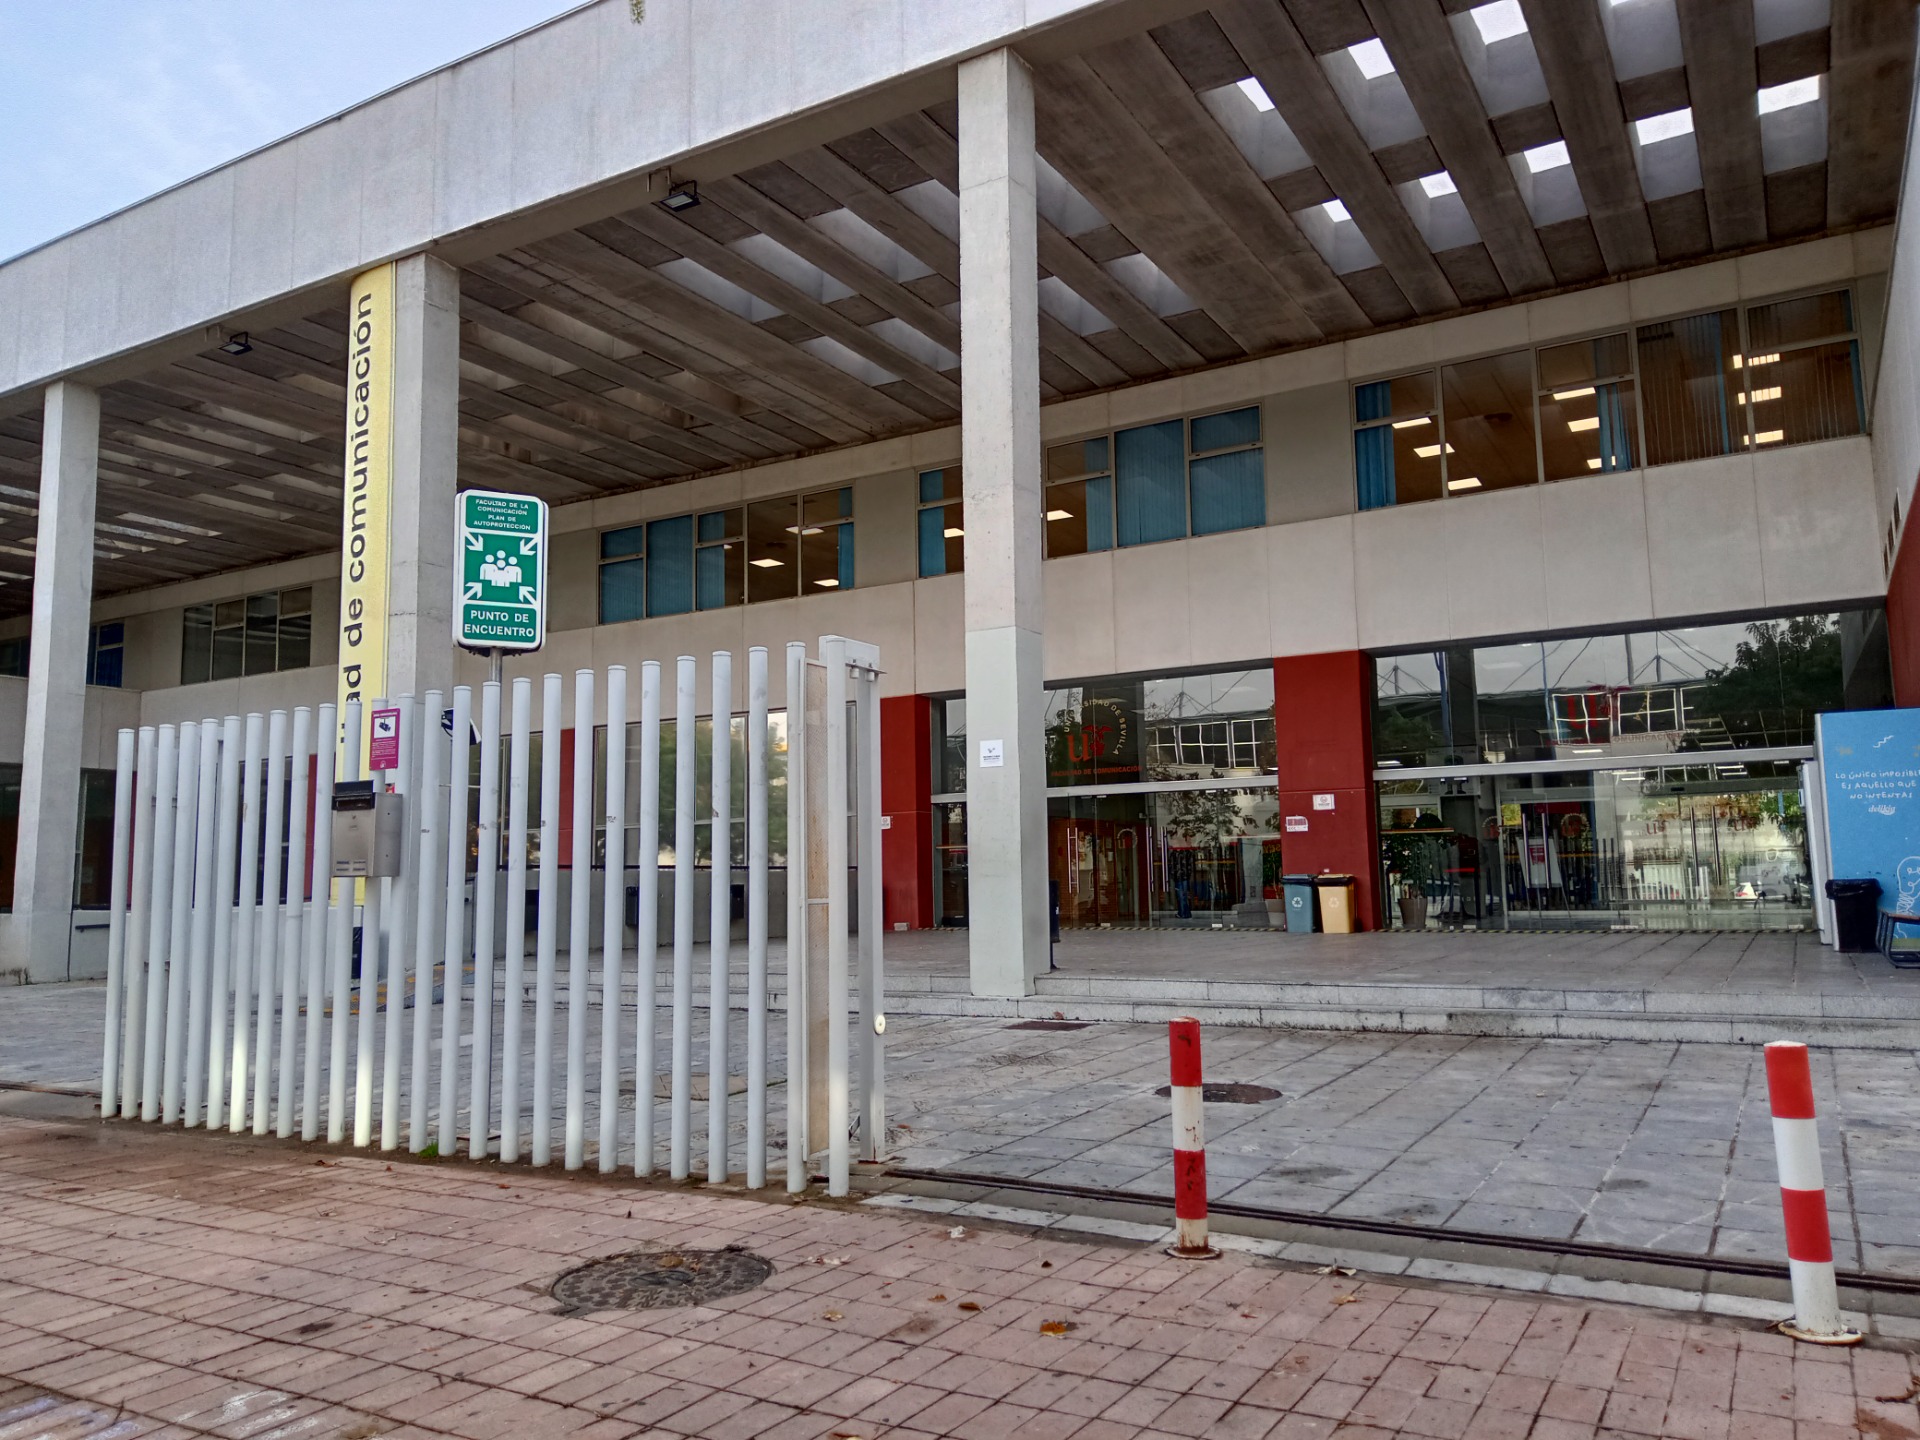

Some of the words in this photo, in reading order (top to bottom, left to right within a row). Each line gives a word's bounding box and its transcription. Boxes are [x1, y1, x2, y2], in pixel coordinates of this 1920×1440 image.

[349, 293, 373, 583] comunicación
[475, 499, 507, 507] FACULTAD
[343, 598, 364, 647] de
[470, 610, 509, 622] PUNTO
[514, 613, 530, 623] DE
[464, 623, 535, 637] ENCUENTRO
[1110, 704, 1122, 716] DE
[1855, 780, 1895, 790] AQUELLO
[1897, 780, 1917, 788] QUE
